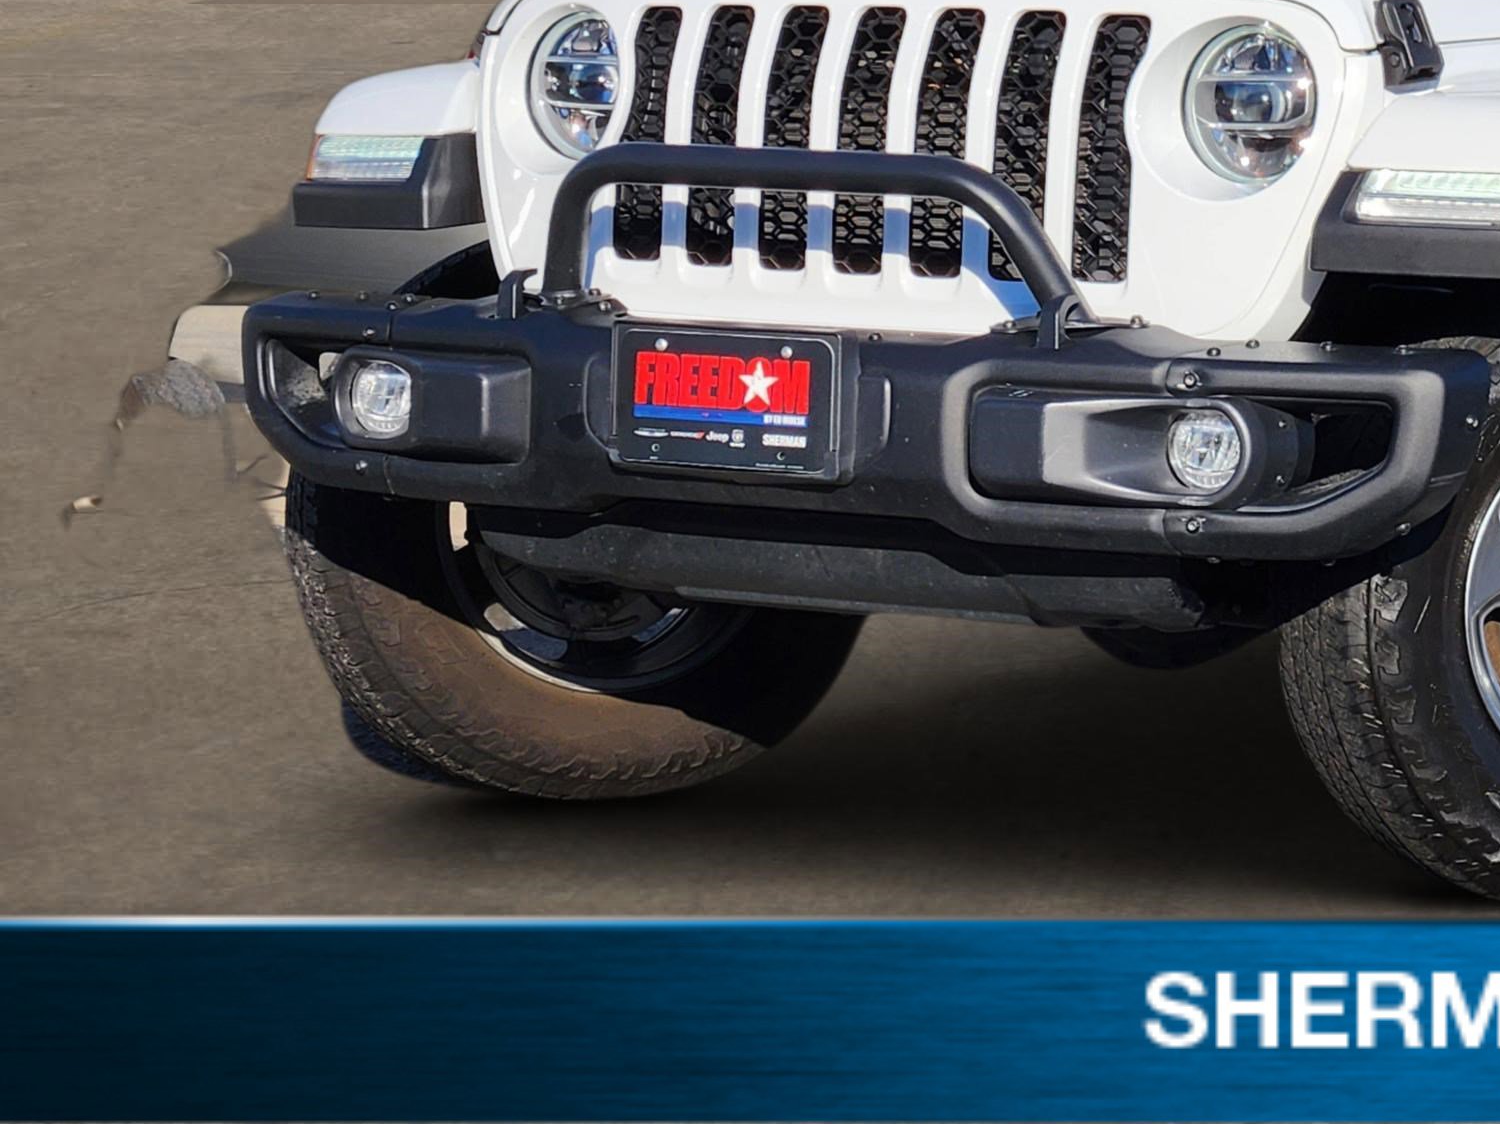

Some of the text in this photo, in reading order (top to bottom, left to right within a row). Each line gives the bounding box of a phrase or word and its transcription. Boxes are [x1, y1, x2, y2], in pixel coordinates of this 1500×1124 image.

[634, 351, 812, 415] FREEDOM
[706, 430, 730, 444] Jeep
[762, 433, 808, 449] SHERMAN
